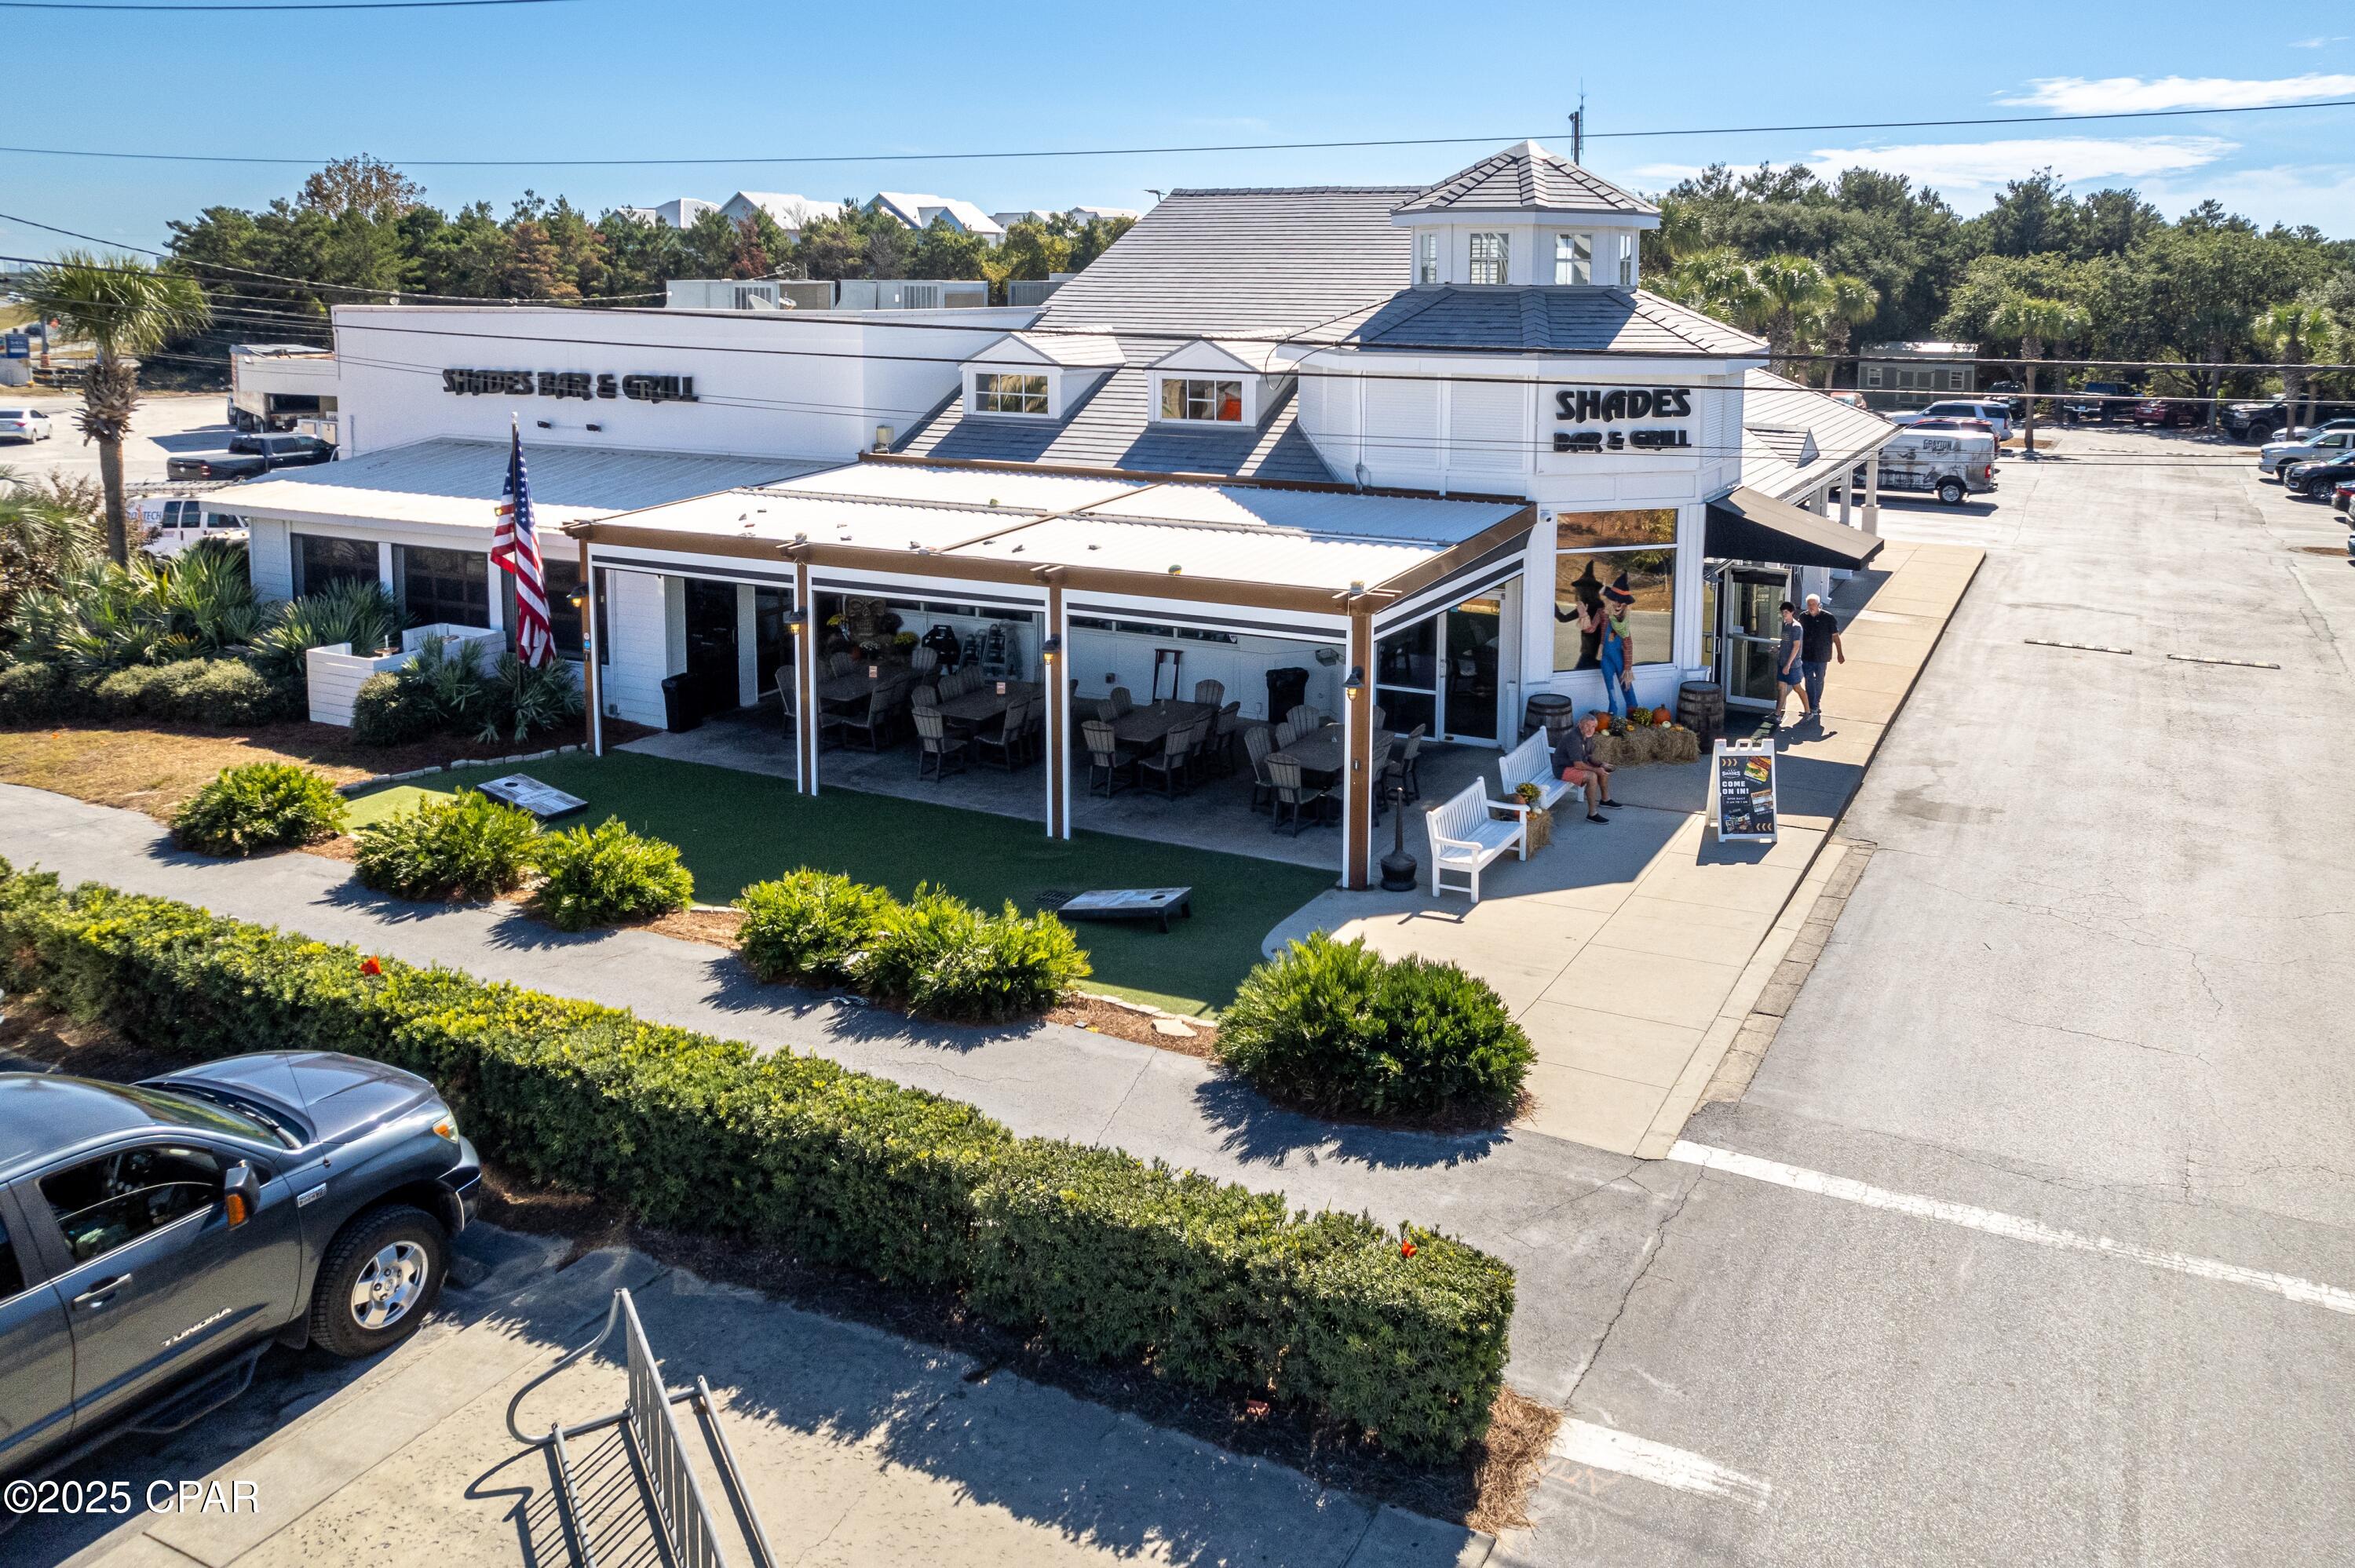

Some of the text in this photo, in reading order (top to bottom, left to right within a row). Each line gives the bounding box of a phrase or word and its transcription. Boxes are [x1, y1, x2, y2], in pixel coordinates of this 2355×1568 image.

[442, 368, 699, 403] SHADES BAR & GRILL
[1556, 388, 1691, 423] SHADES
[1554, 430, 1692, 453] BAR & GRILL
[1923, 439, 1952, 450] GRAYTON
[143, 511, 162, 520] TECH
[162, 1307, 232, 1346] TUNDRA
